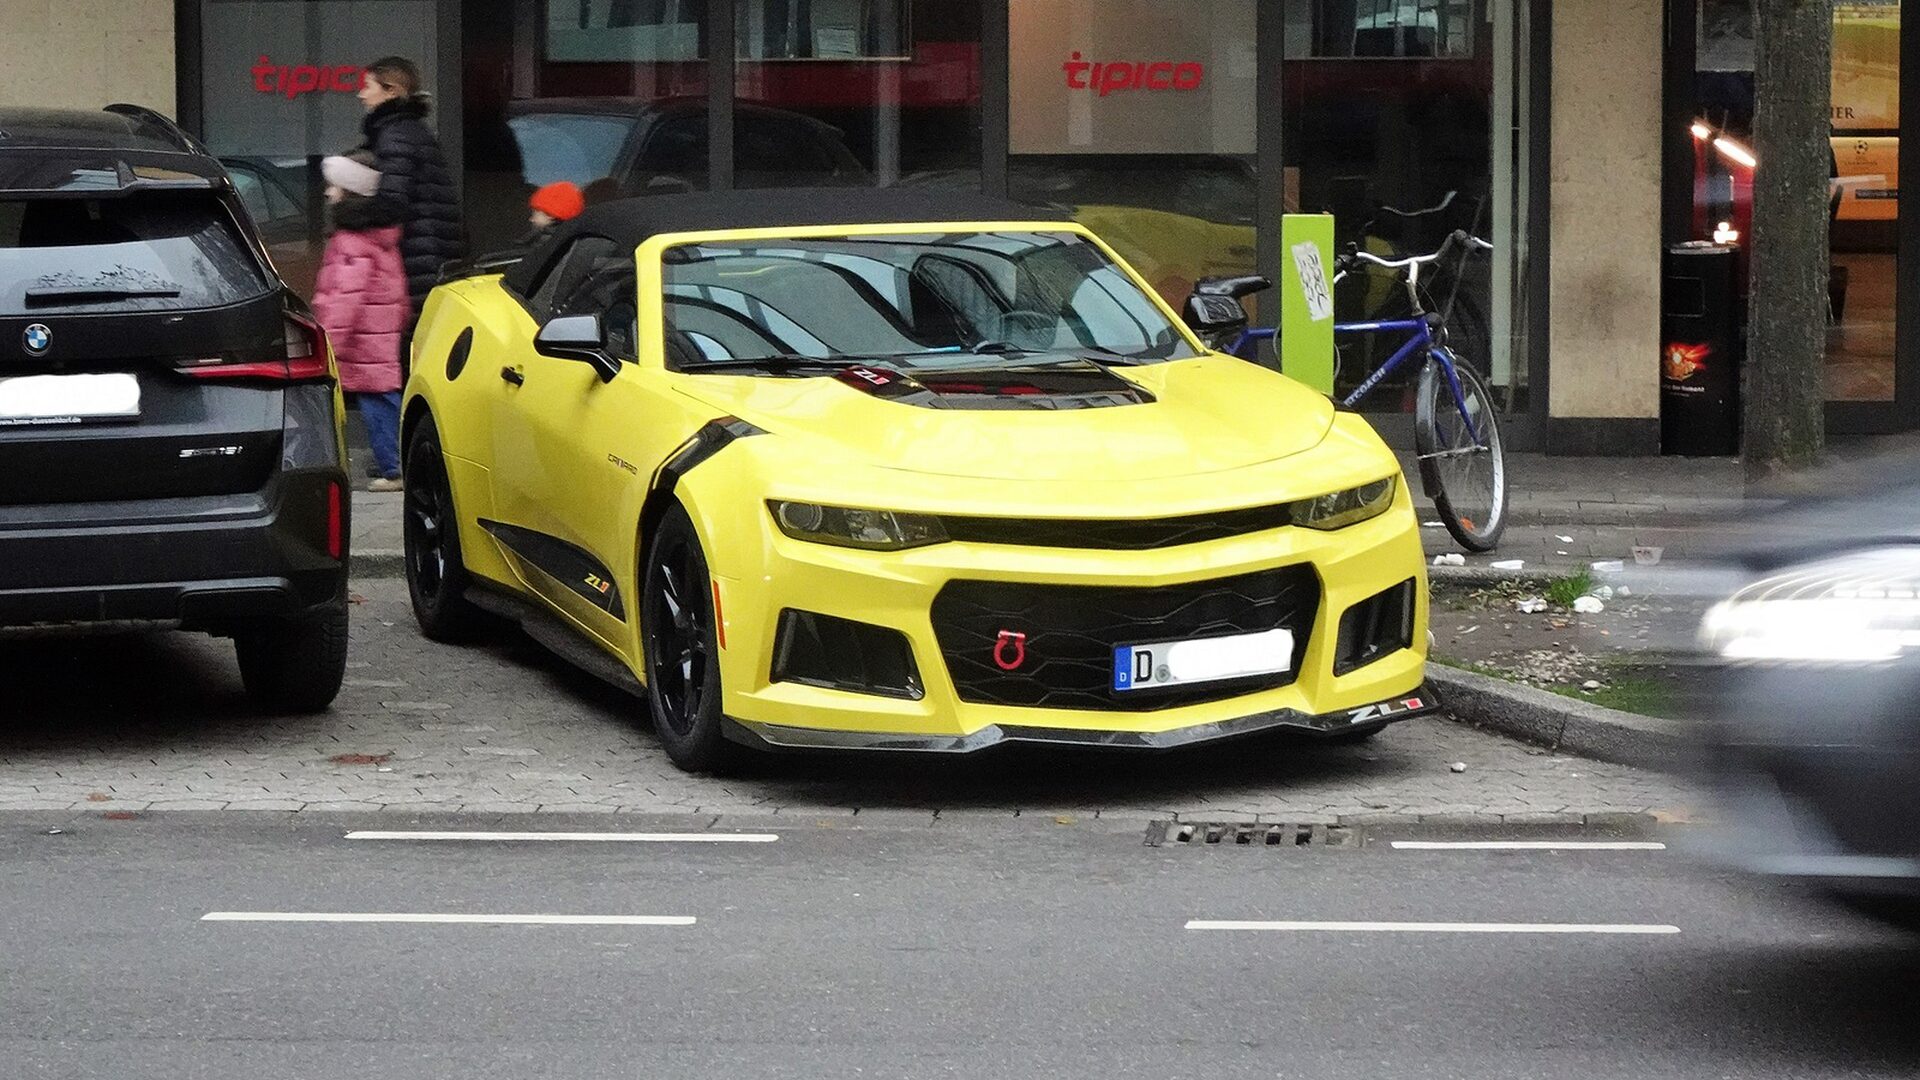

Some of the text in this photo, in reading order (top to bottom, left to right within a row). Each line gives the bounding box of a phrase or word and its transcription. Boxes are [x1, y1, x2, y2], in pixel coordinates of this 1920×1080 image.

[1063, 51, 1203, 96] tipico
[853, 368, 890, 385] ZL1
[584, 572, 610, 593] ZL1
[1120, 672, 1126, 682] D
[1135, 650, 1152, 682] D
[1347, 698, 1424, 724] ZL1
